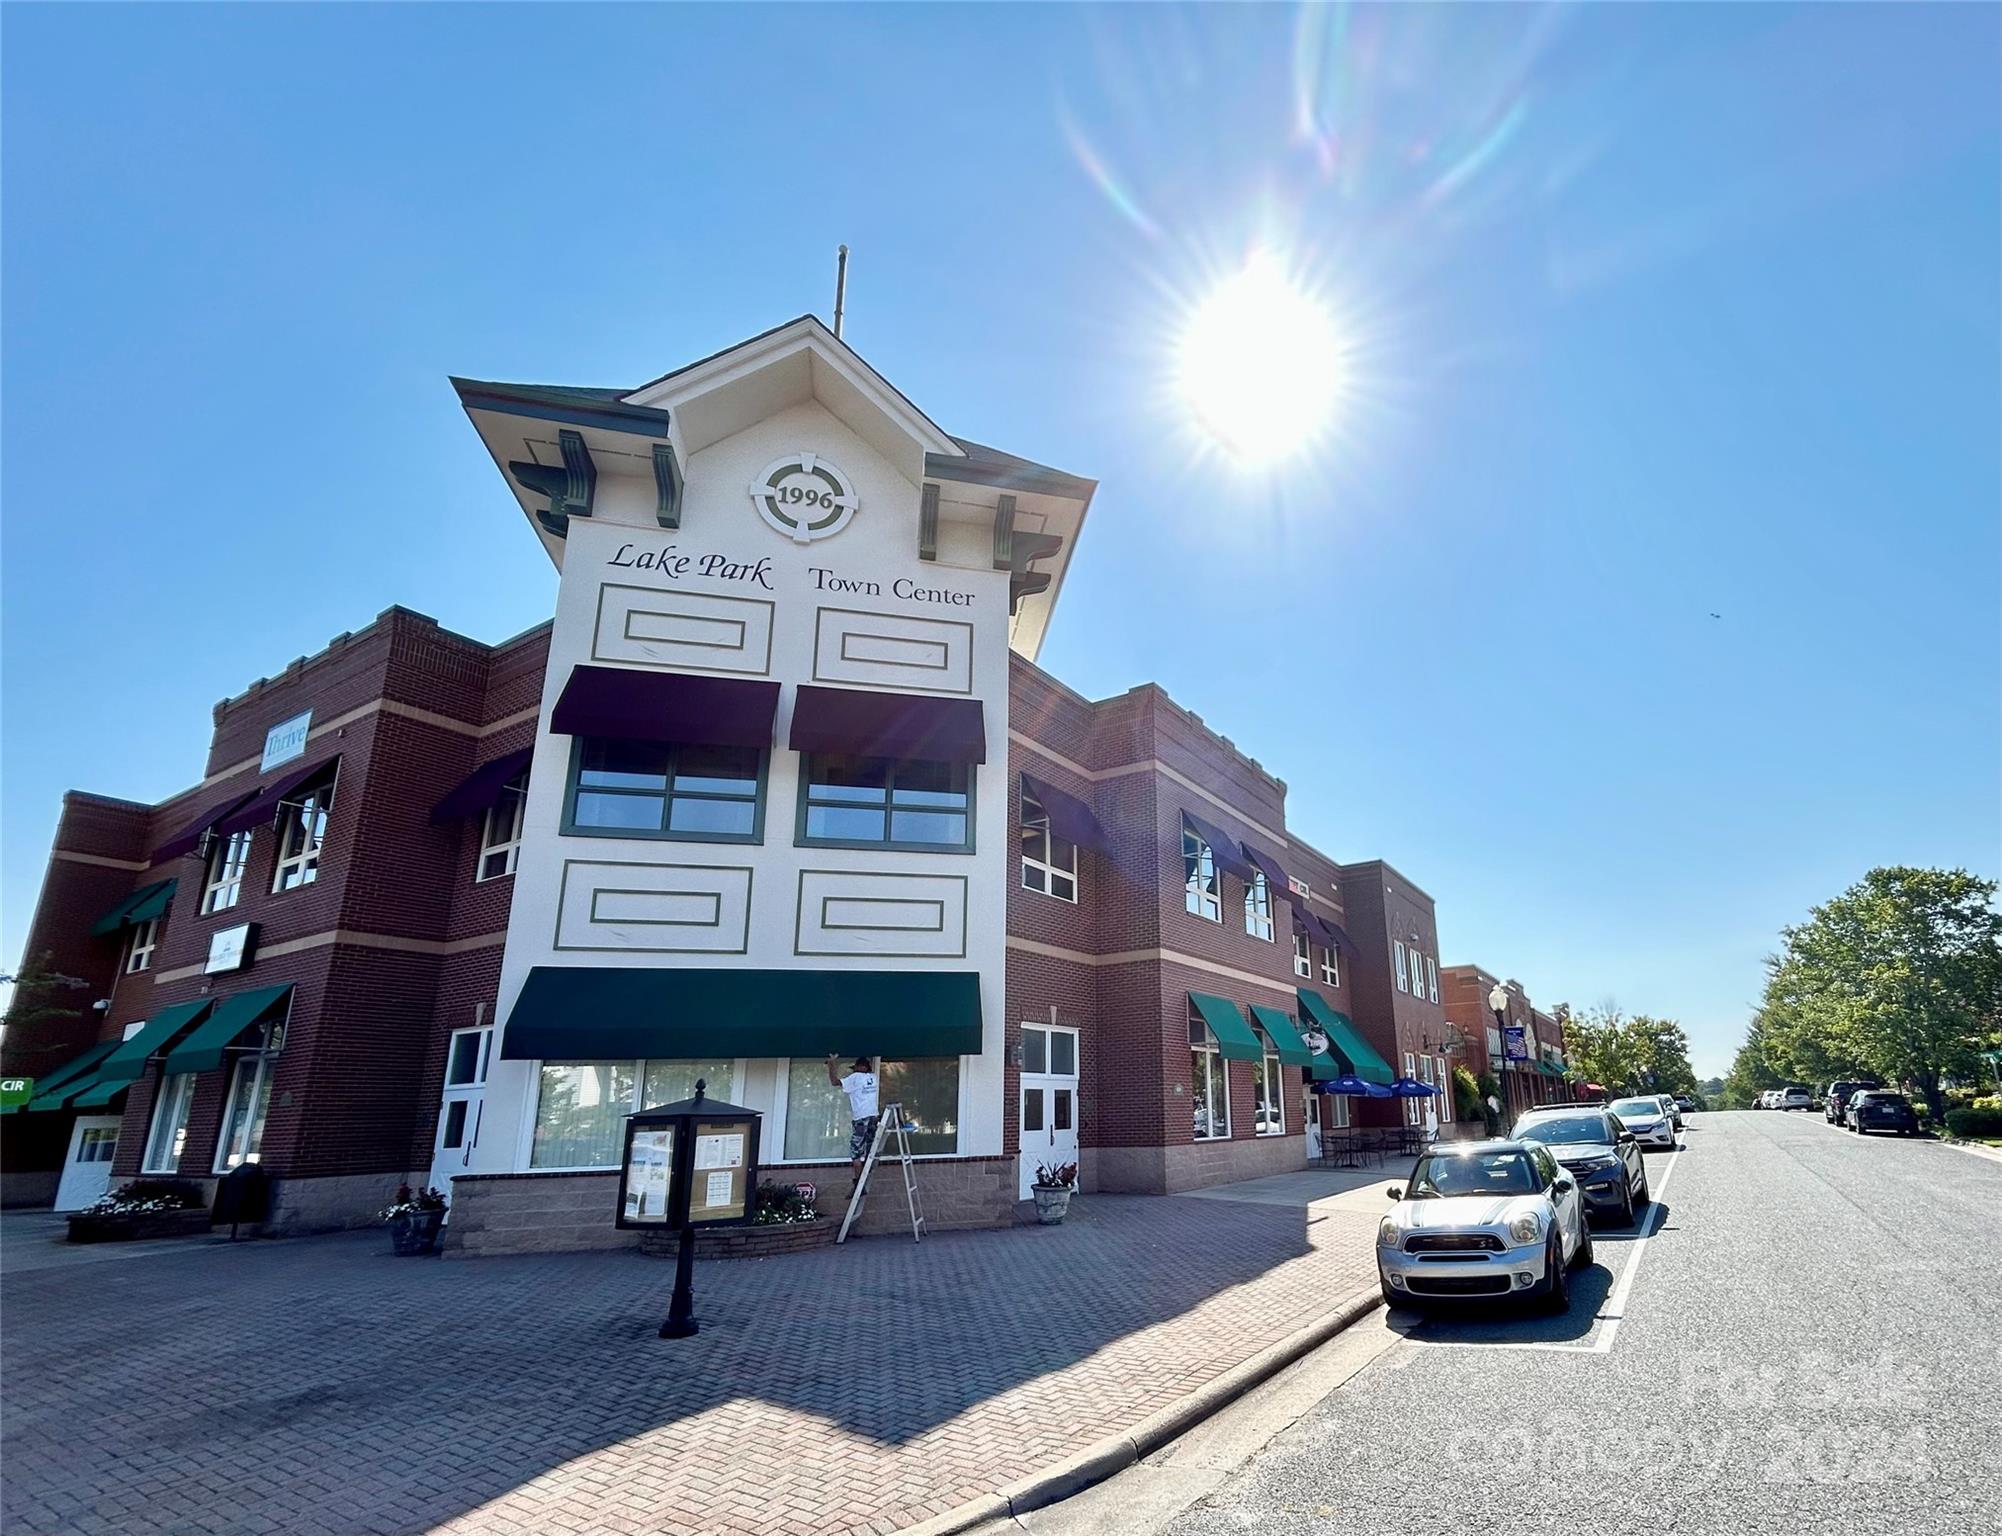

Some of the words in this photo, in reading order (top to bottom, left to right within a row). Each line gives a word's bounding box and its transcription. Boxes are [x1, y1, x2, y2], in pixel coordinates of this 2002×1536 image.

[778, 485, 834, 509] 1996
[607, 543, 690, 579] Lake
[698, 553, 775, 590] Park
[808, 566, 881, 597] Town
[893, 577, 976, 607] Center
[266, 726, 306, 756] Thrive
[0, 1080, 25, 1091] CIR
